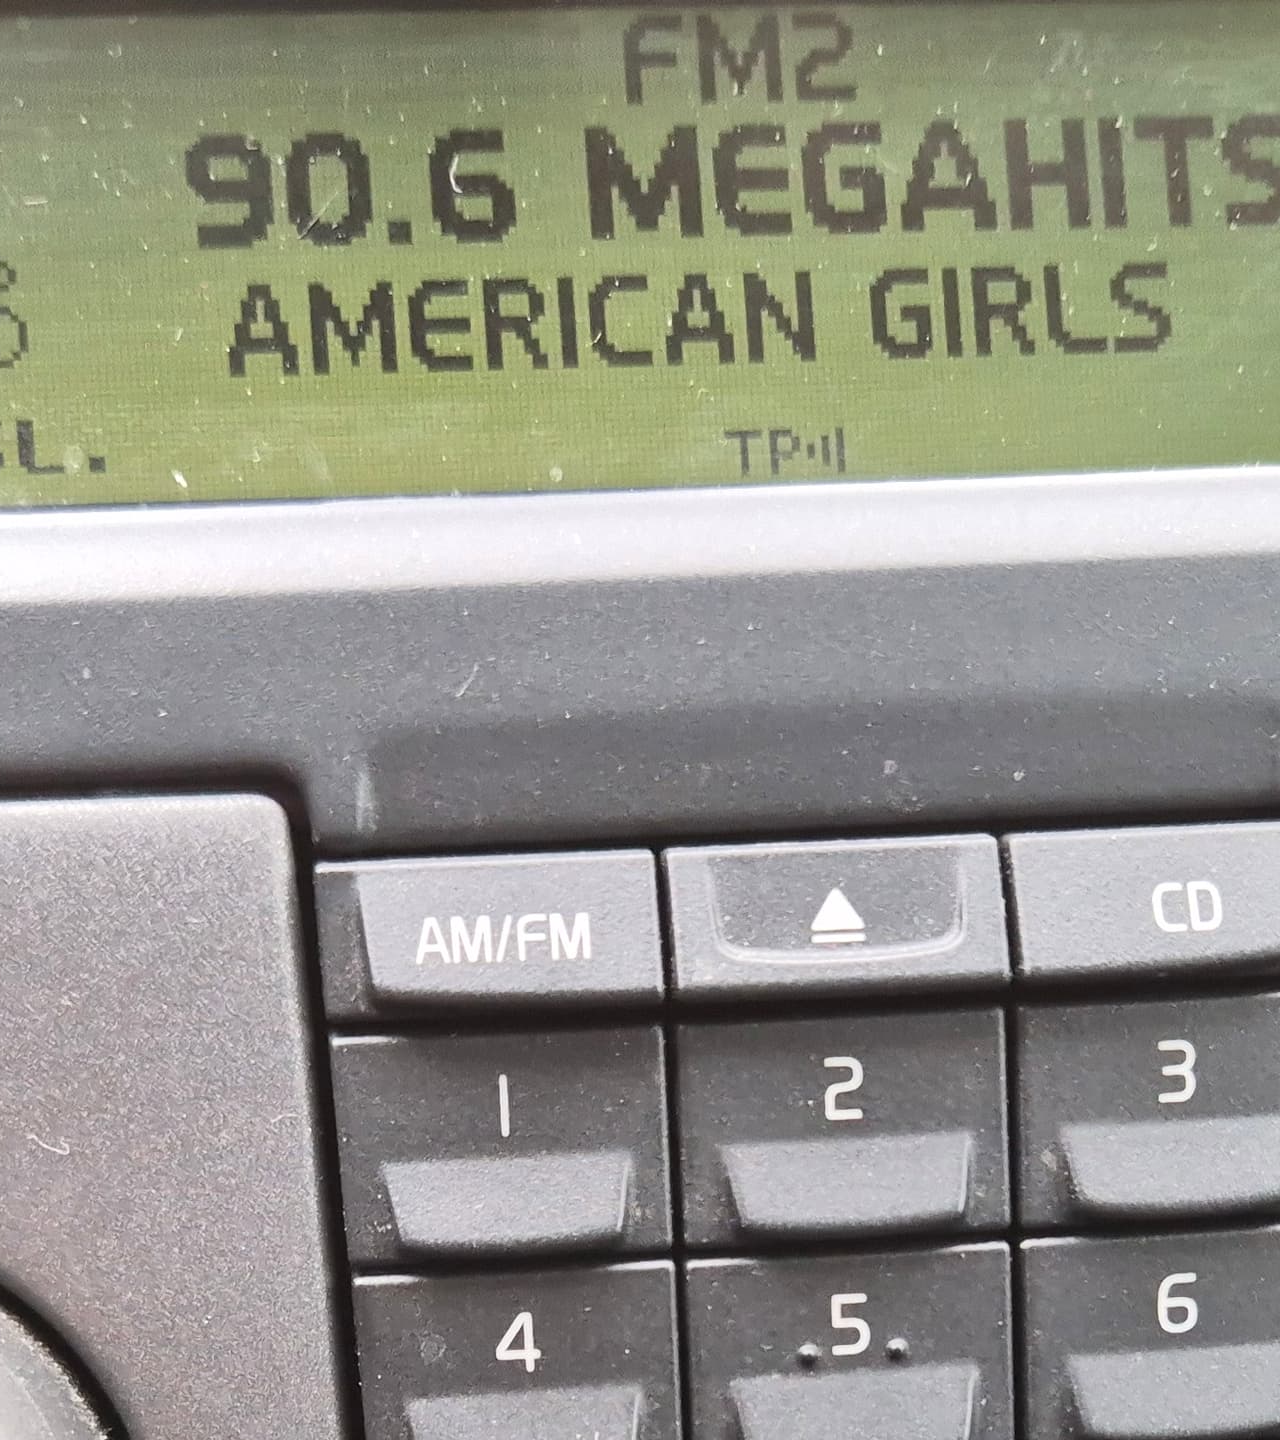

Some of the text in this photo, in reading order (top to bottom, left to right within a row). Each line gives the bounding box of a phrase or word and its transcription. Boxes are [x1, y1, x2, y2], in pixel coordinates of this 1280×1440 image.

[622, 12, 858, 105] FM2
[184, 127, 518, 249] 90.6
[227, 261, 1172, 379] AMERICAN GIRLS
[415, 911, 593, 965] AM/FM
[1151, 880, 1223, 934] CD
[823, 1056, 866, 1121] 2
[1157, 1039, 1197, 1103] 3
[498, 1074, 510, 1138] 1
[830, 1293, 870, 1354] 5
[1157, 1272, 1199, 1334] 6
[494, 1311, 542, 1373] 4
